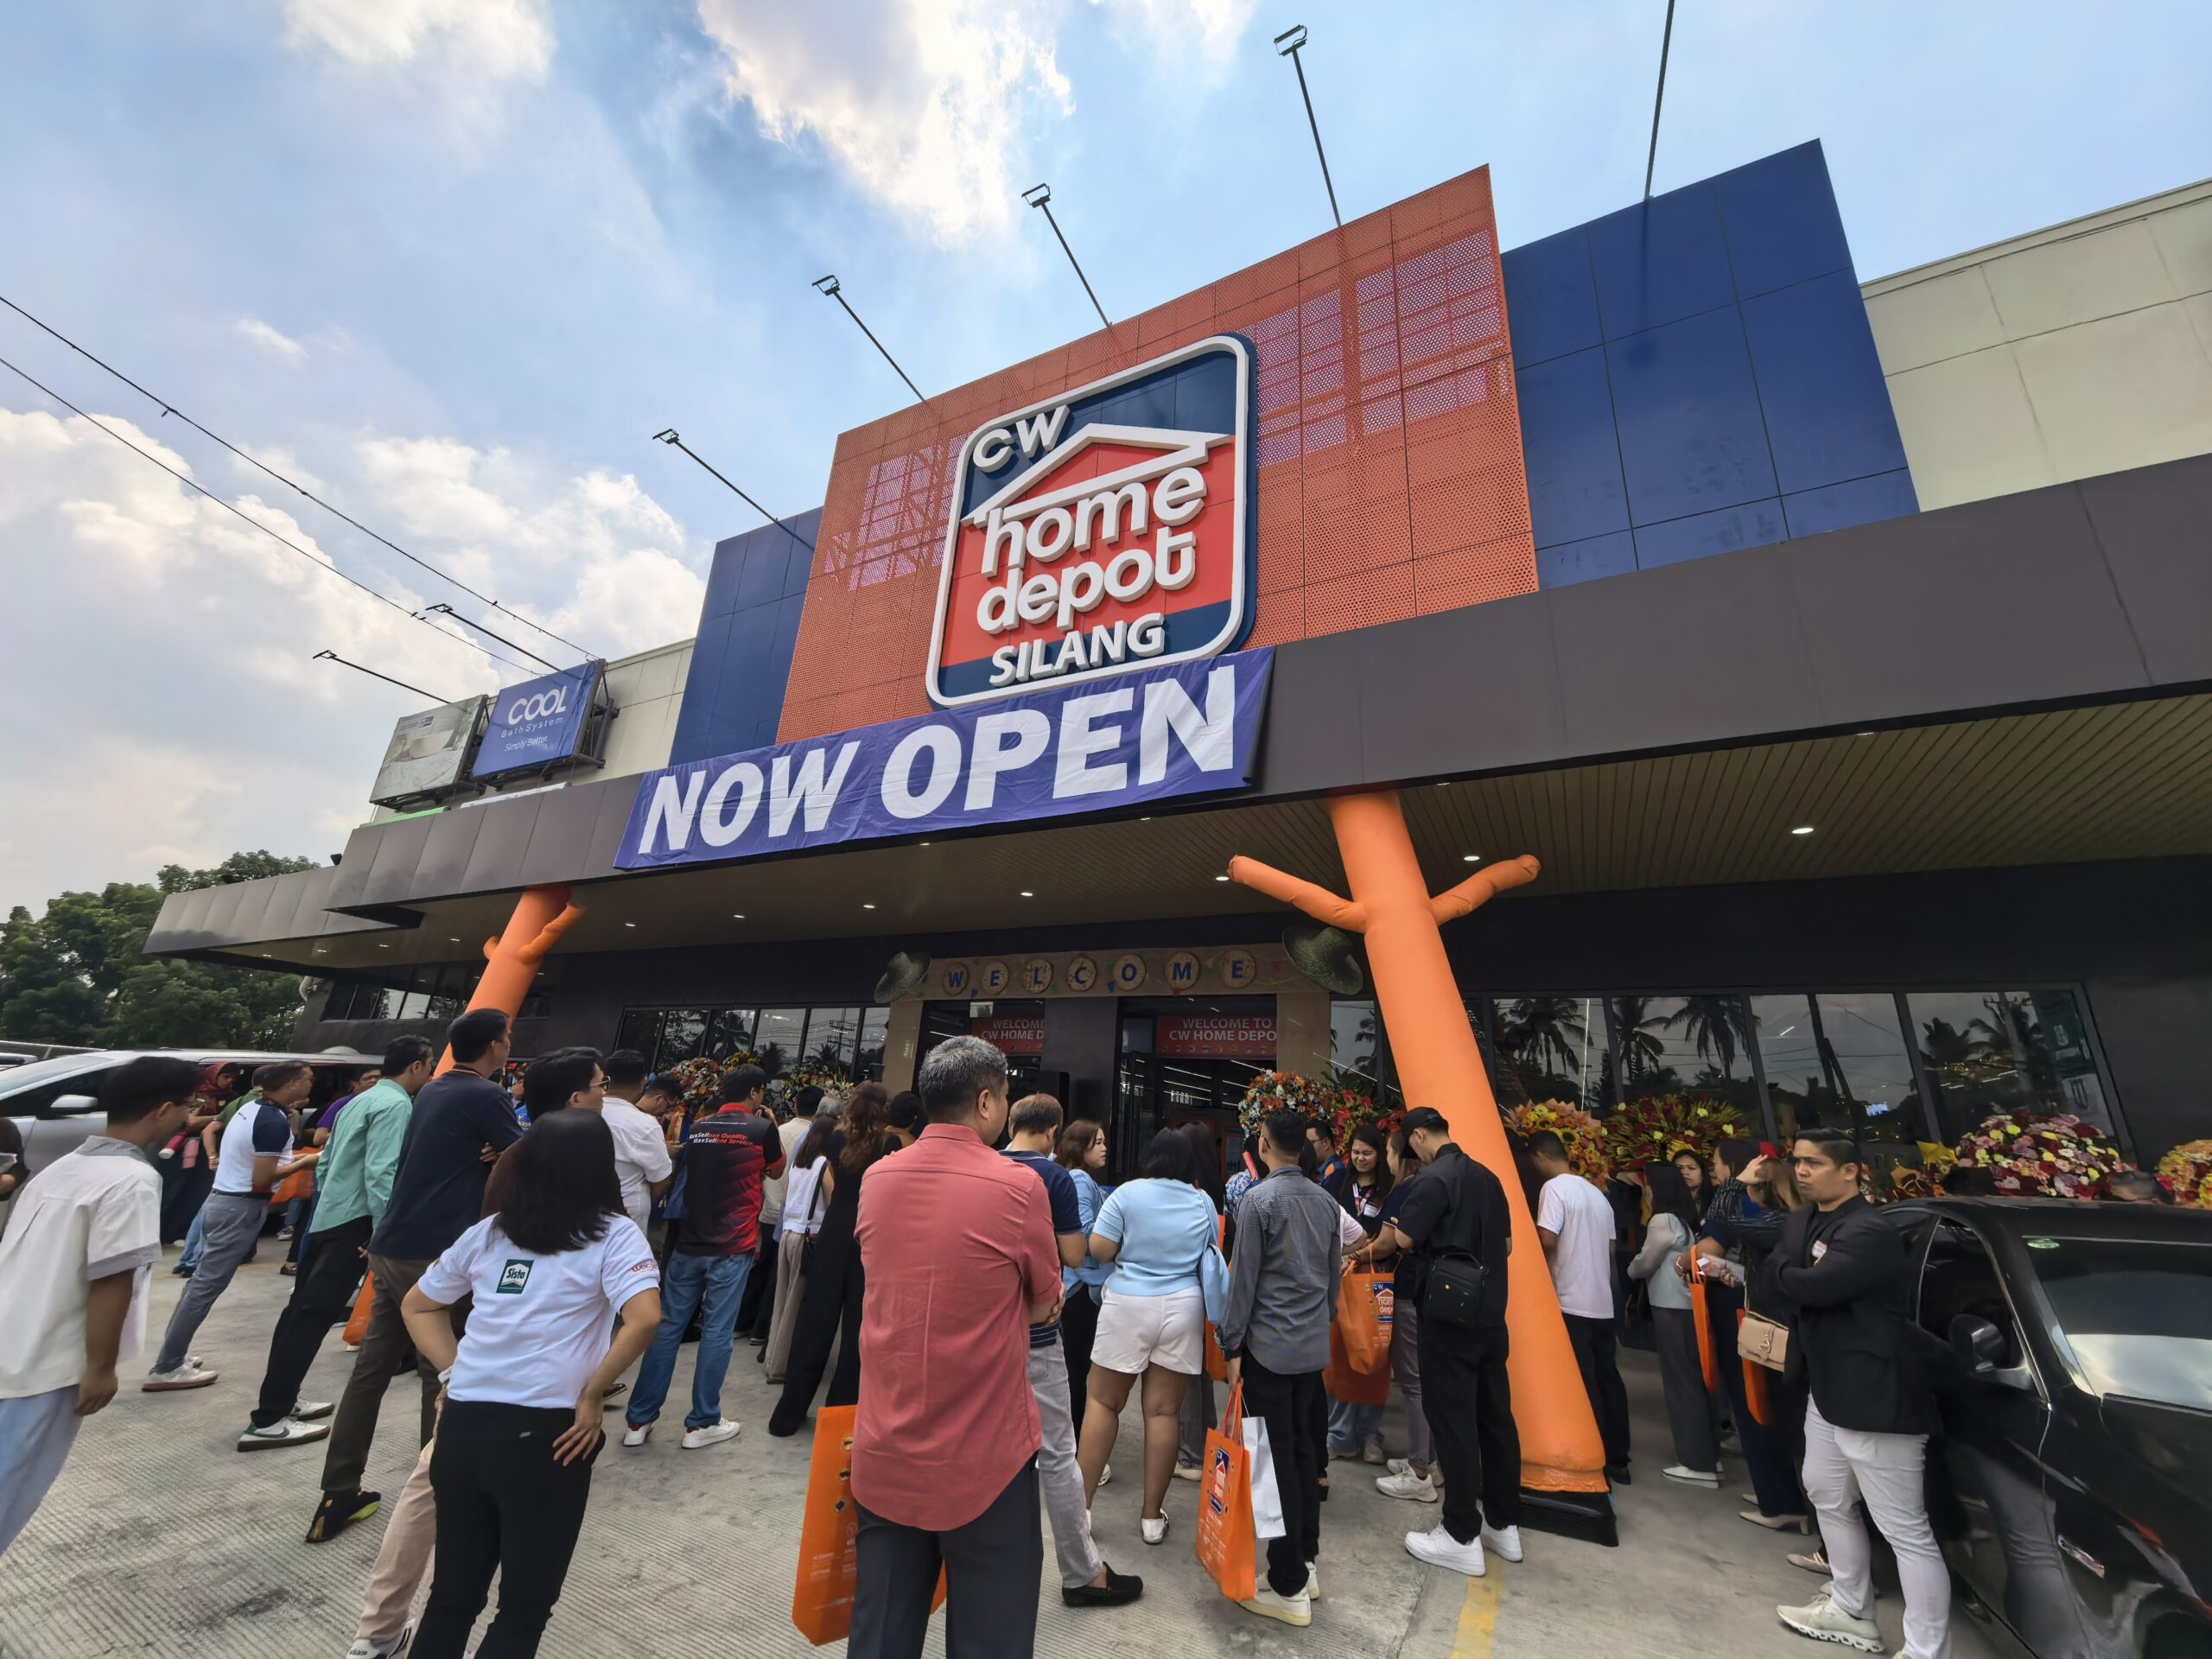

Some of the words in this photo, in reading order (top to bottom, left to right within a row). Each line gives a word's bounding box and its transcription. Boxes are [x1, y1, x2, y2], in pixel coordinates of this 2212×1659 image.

[972, 404, 1071, 474] CW
[981, 467, 1207, 578] home
[976, 526, 1197, 635] depot
[988, 613, 1166, 688] SILANG
[508, 685, 567, 725] COOL
[525, 717, 563, 732] System
[638, 741, 862, 855] NOW
[880, 664, 1236, 819] OPEN
[947, 959, 1245, 988] WELCOME
[982, 1030, 999, 1039] CW
[1001, 1030, 1033, 1040] HOME
[1169, 1030, 1191, 1041] CW
[1193, 1030, 1235, 1041] HOME
[1238, 1030, 1277, 1041] DEPO
[1183, 1018, 1249, 1029] WELCOME
[1254, 1018, 1273, 1029] TO
[506, 1268, 526, 1280] Sista
